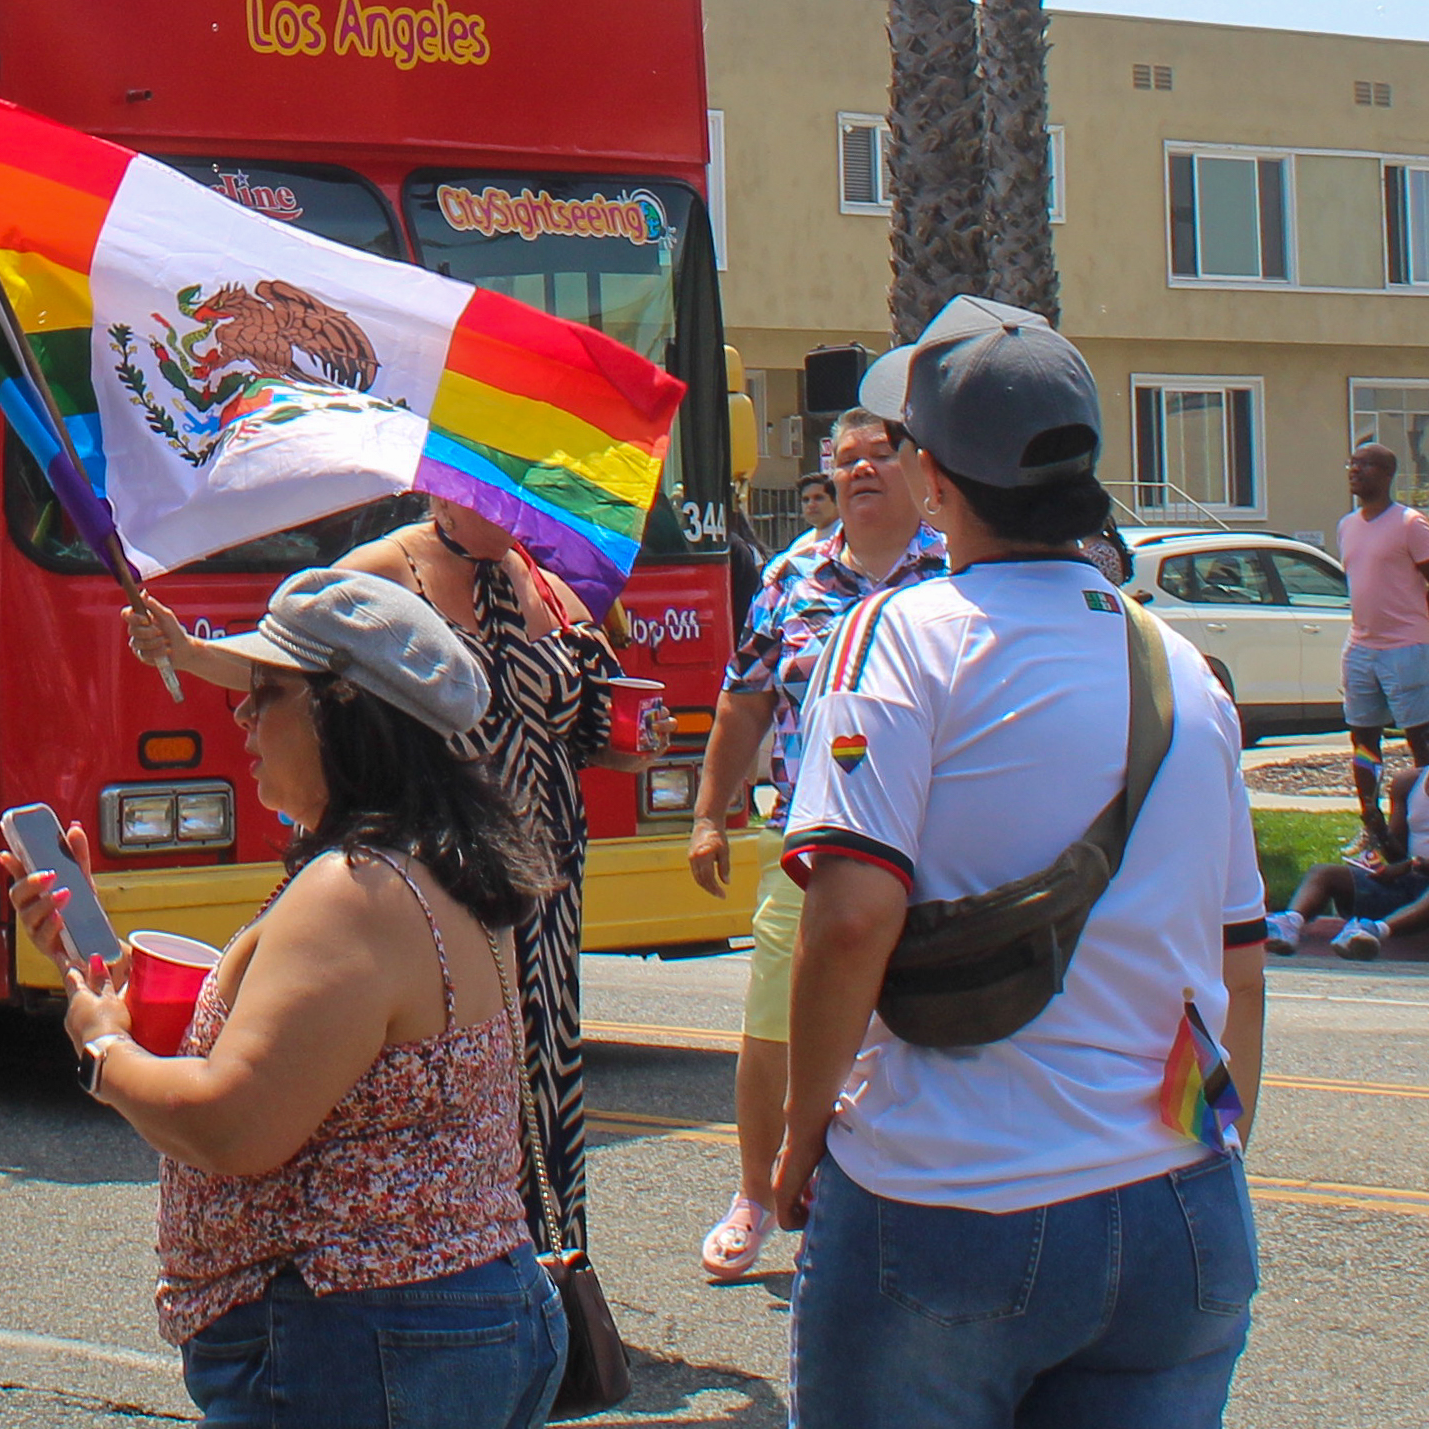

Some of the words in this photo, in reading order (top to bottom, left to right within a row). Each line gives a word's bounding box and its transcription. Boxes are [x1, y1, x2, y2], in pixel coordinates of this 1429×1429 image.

[438, 185, 649, 245] CitySightseeing
[682, 501, 727, 543] 344
[665, 608, 701, 641] Off
